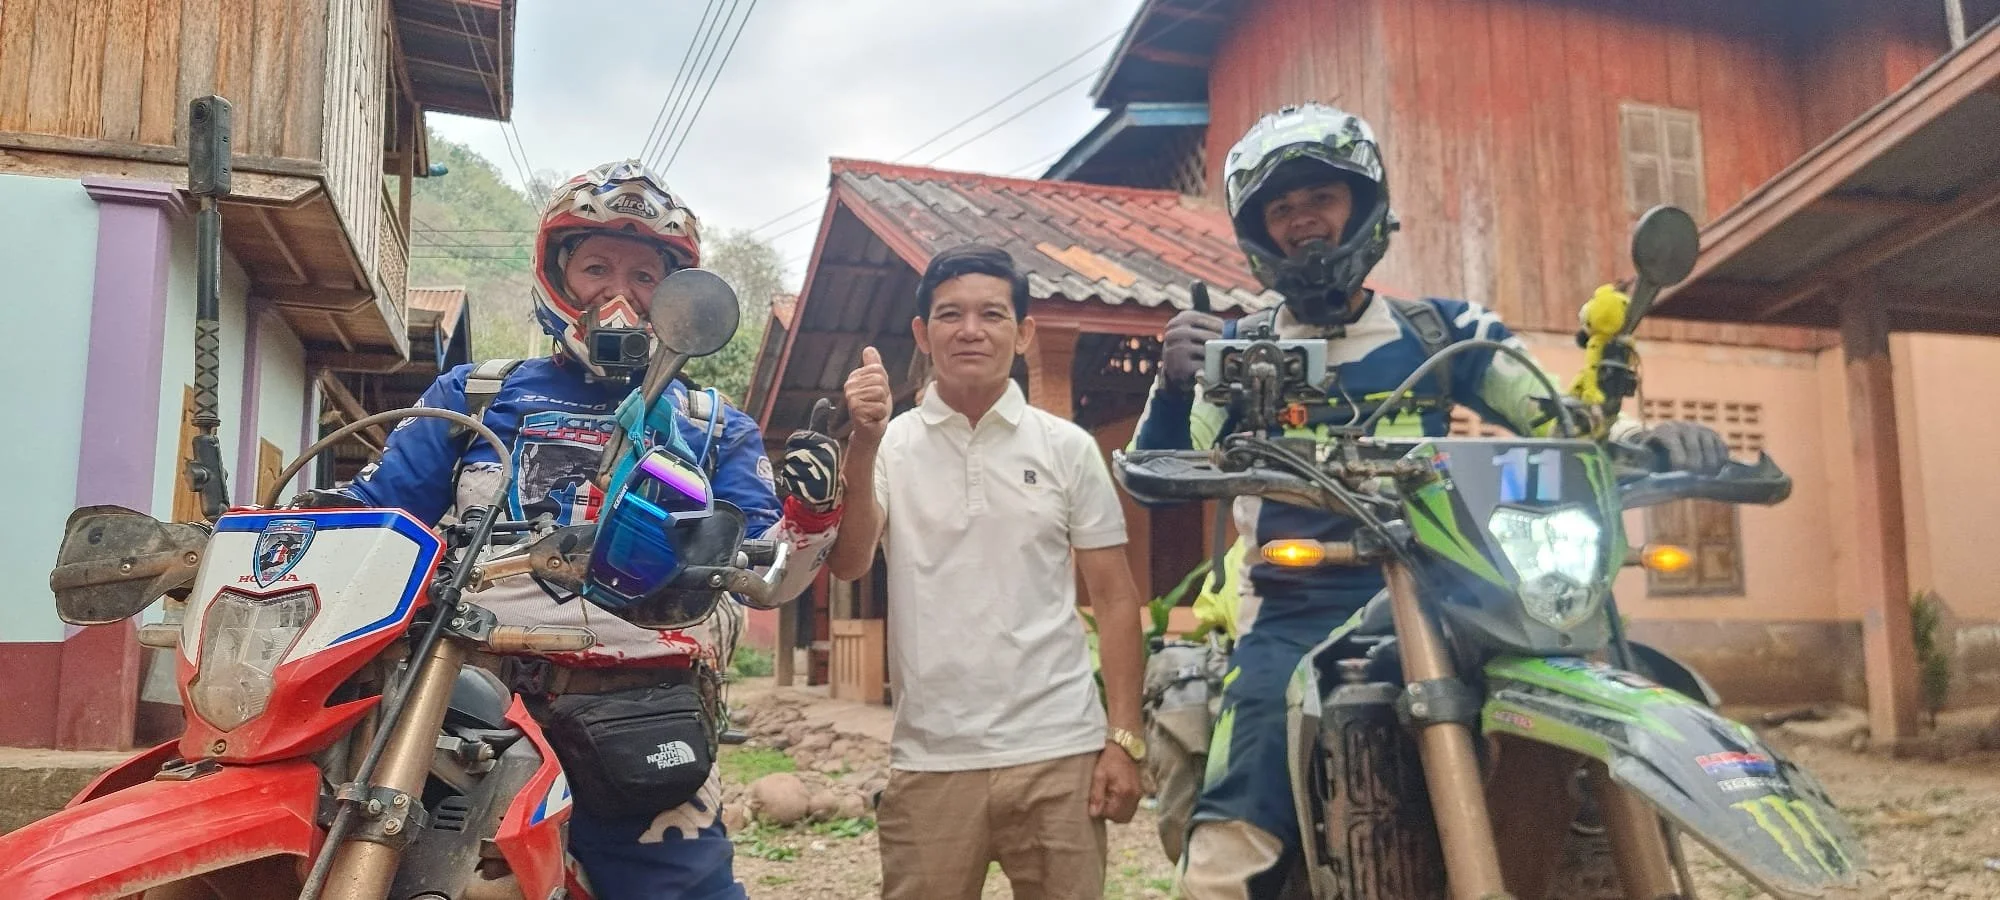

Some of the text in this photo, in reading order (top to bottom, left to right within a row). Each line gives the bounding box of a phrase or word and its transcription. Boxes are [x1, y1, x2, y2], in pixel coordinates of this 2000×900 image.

[1492, 447, 1562, 503] 11
[239, 574, 299, 582] HOA
[657, 741, 676, 752] THE
[646, 749, 679, 764] NORTH
[657, 757, 681, 769] FACE
